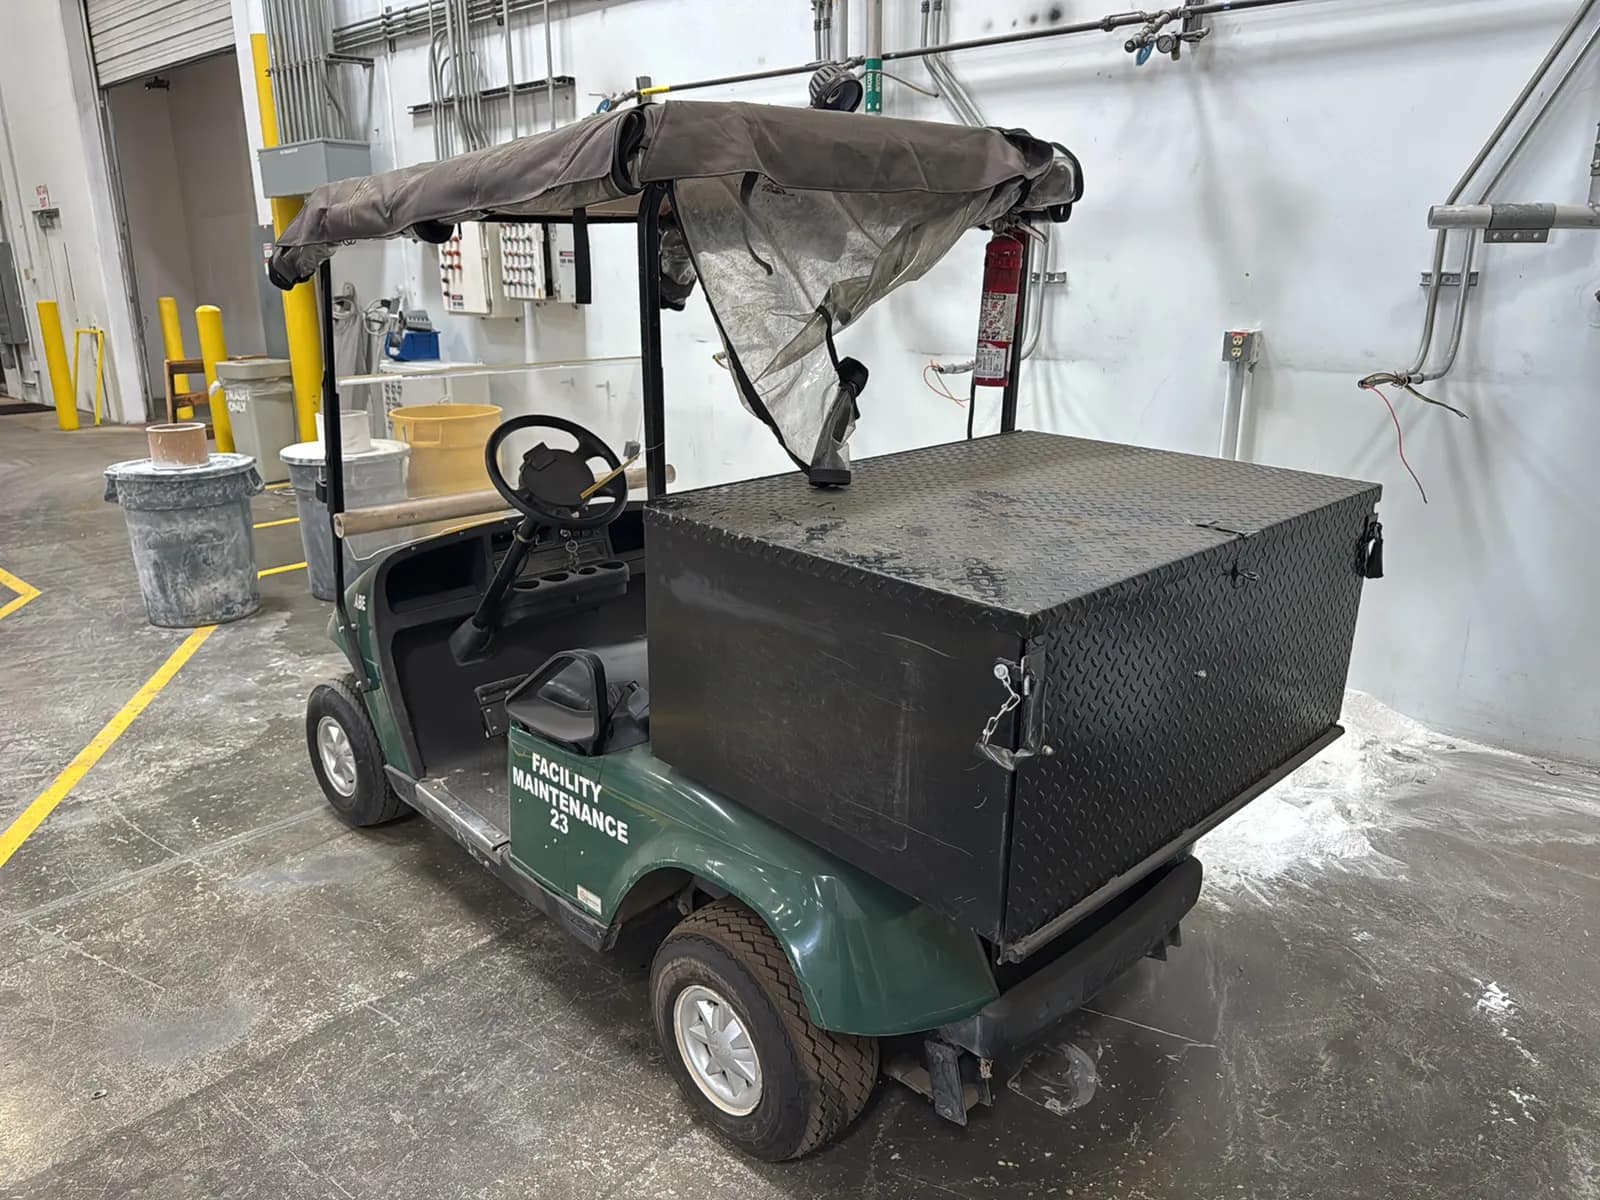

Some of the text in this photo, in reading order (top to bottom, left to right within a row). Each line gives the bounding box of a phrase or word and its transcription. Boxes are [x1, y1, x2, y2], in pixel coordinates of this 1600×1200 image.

[532, 752, 602, 804] FACILITY
[513, 766, 629, 845] MAINTENANCE
[550, 808, 569, 835] 23
